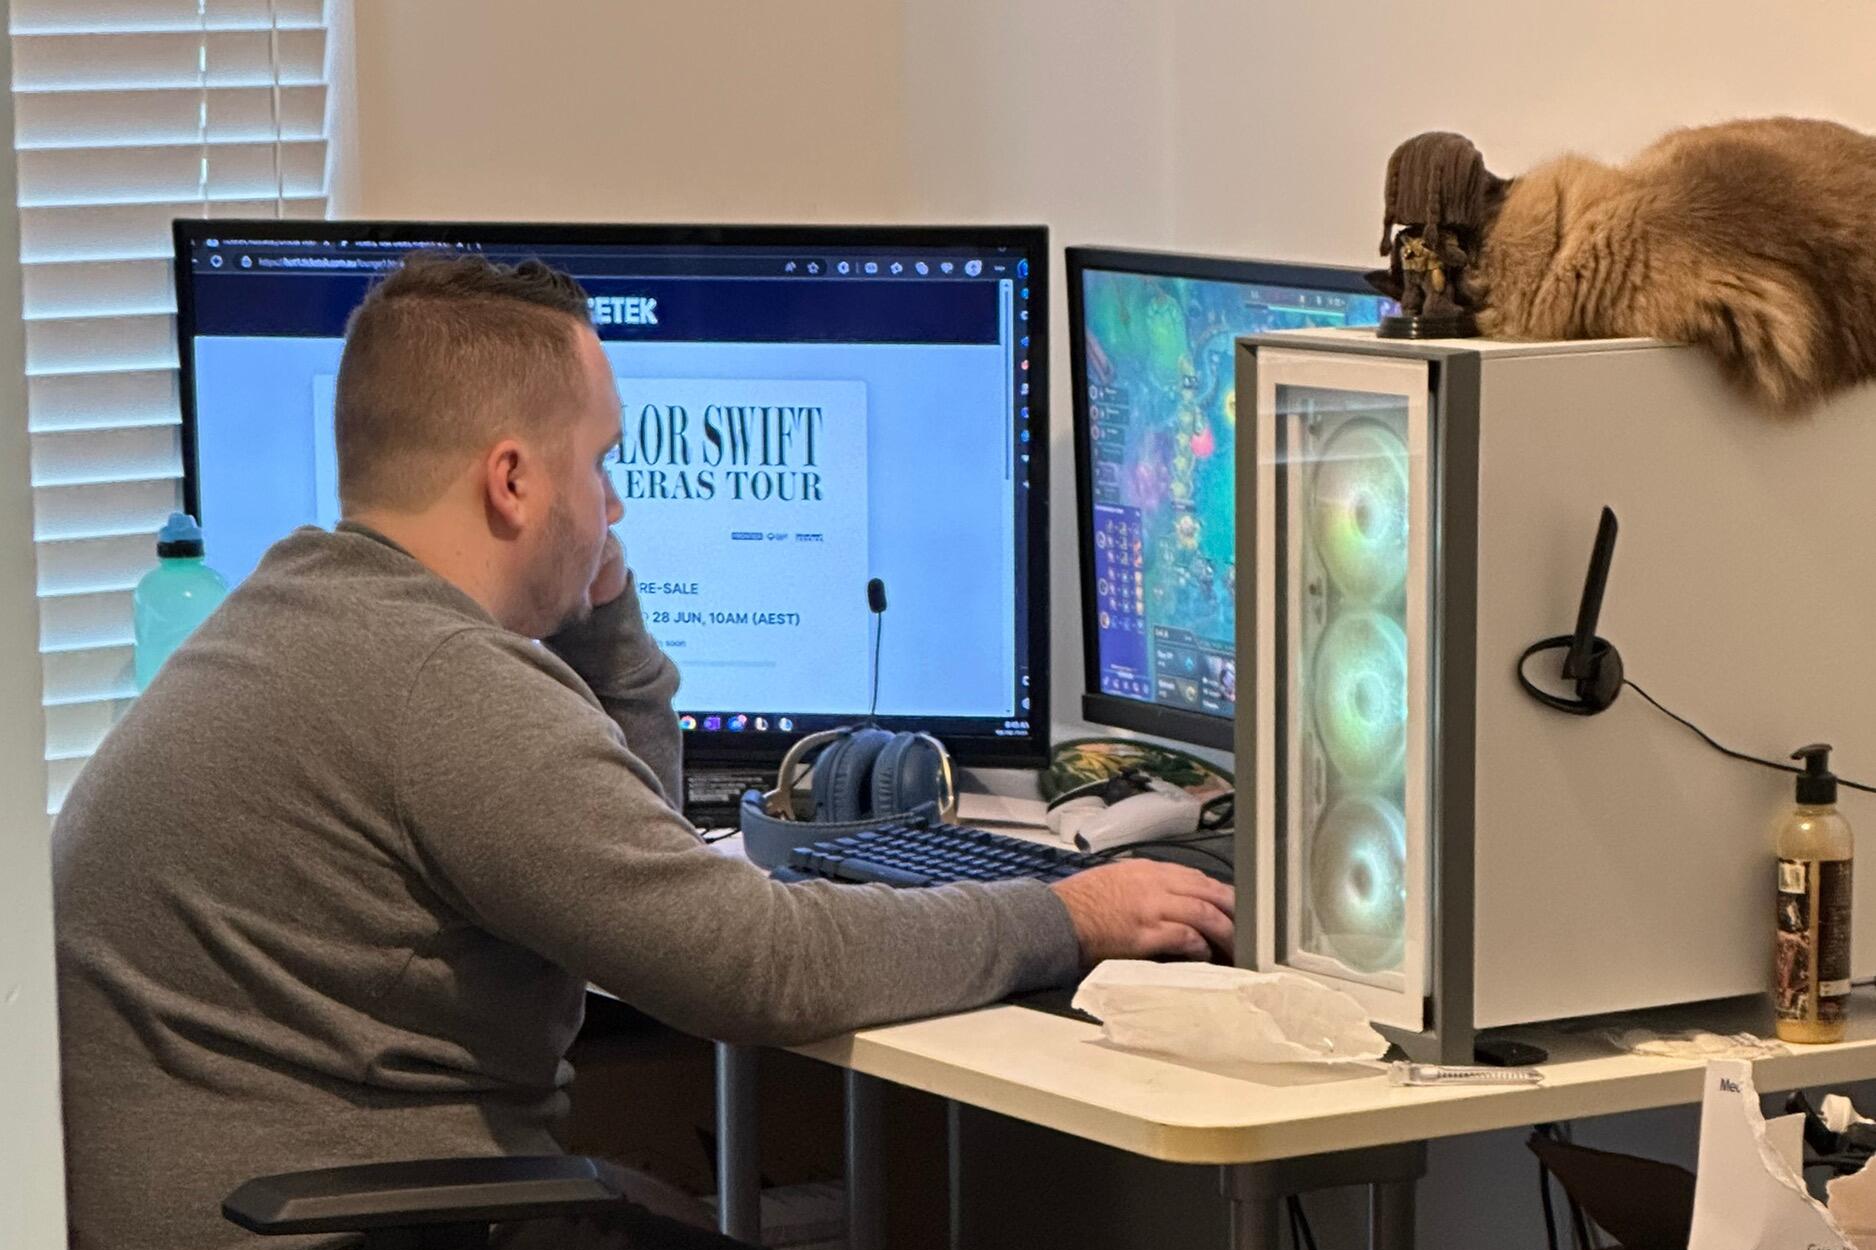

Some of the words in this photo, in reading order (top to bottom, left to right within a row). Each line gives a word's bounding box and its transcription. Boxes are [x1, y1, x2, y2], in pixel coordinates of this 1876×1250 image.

[702, 403, 823, 467] SWIFT
[625, 469, 715, 500] ERAS
[726, 470, 823, 501] TOUR
[652, 611, 670, 624] 28
[673, 611, 707, 627] JUN,
[709, 612, 749, 625] 10AM
[752, 611, 801, 627] (AEST)
